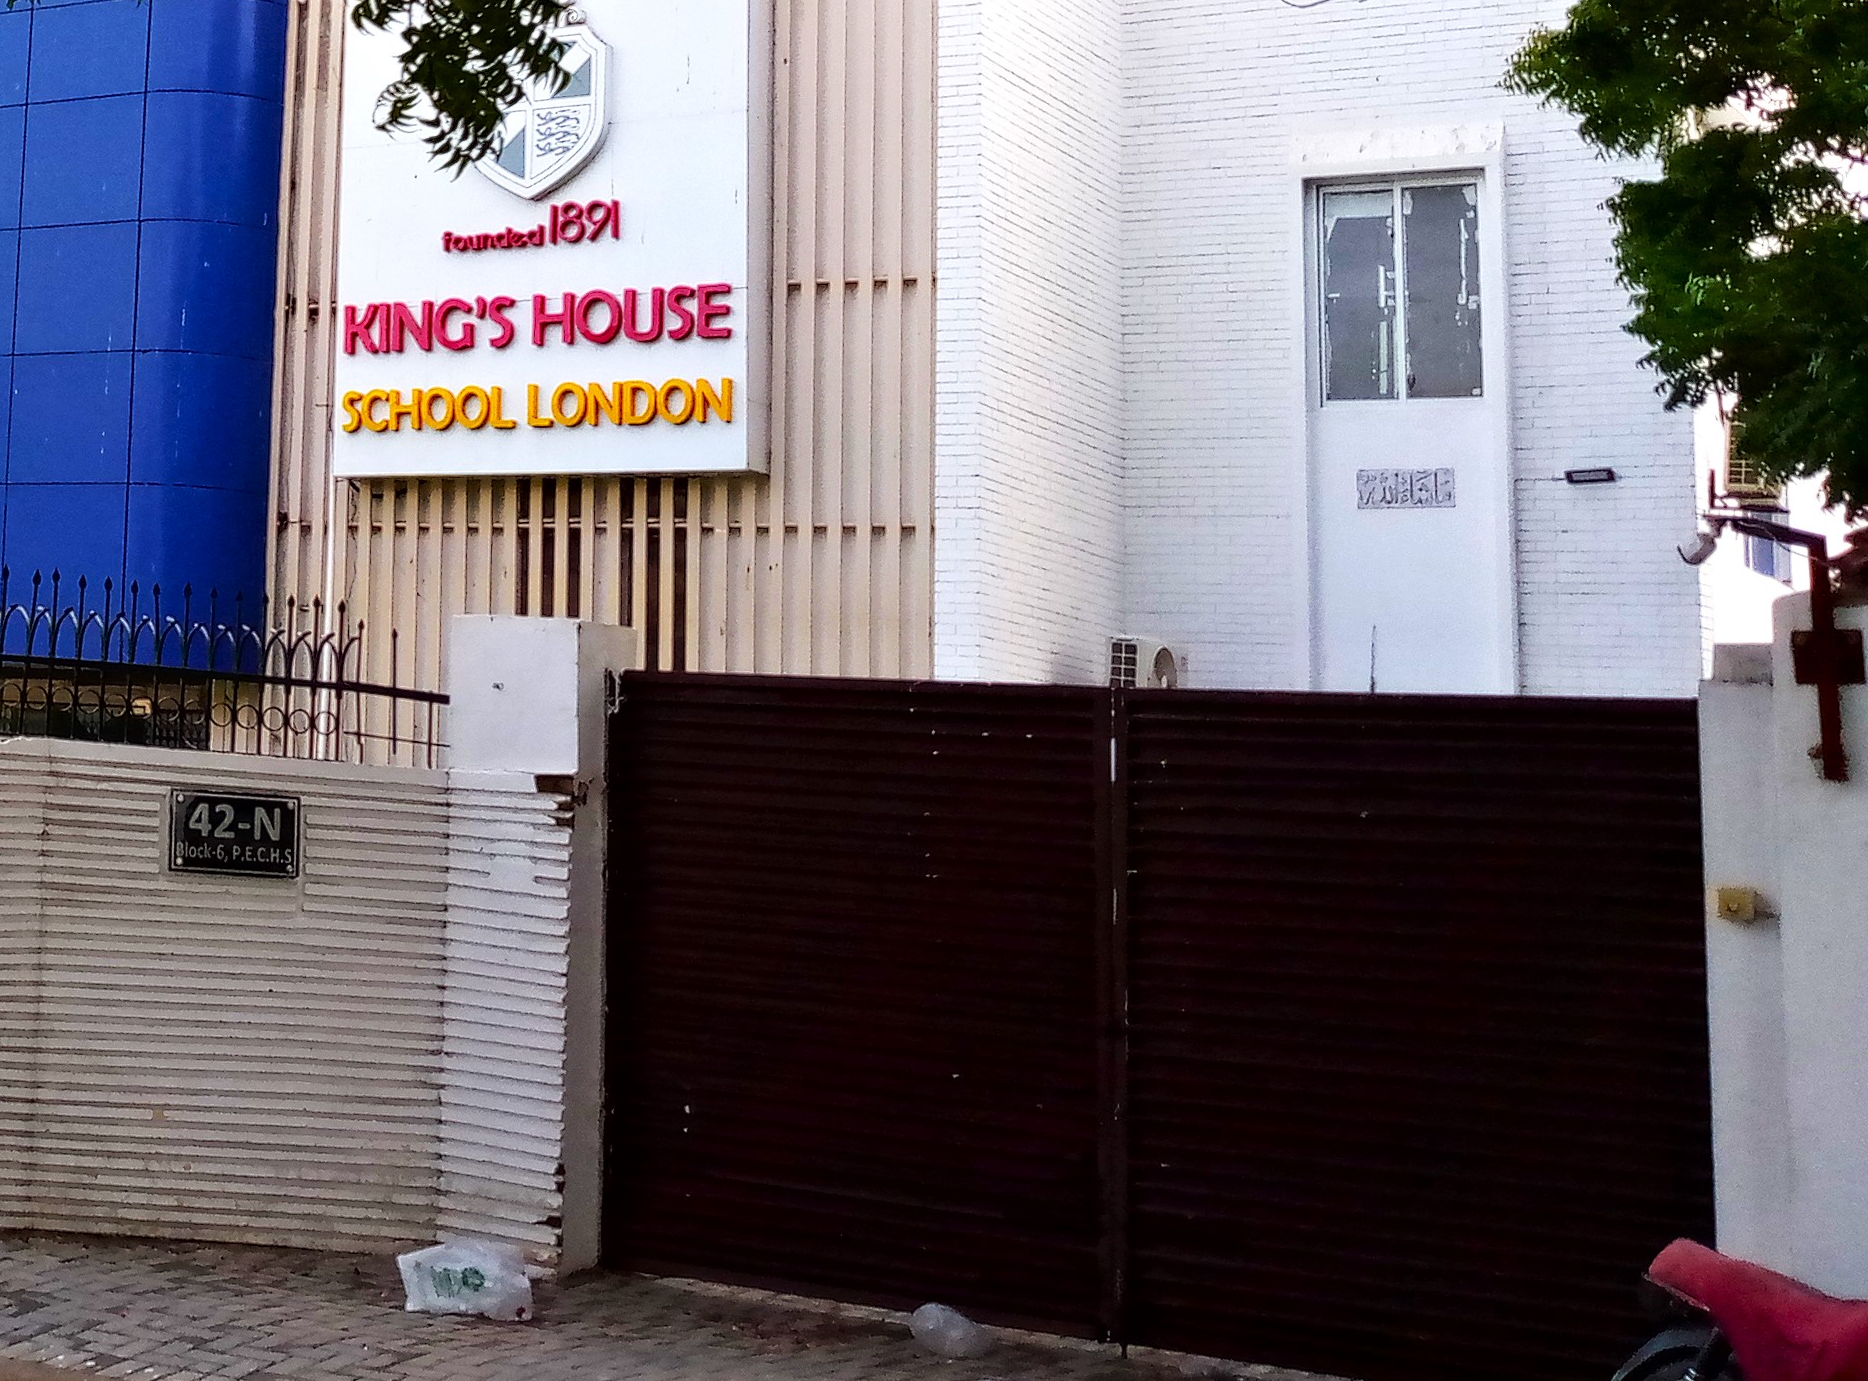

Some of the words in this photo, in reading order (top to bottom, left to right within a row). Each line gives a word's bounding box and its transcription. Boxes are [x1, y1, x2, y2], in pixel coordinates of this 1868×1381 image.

[441, 224, 544, 253] founded
[548, 199, 621, 246] 1891
[343, 295, 516, 356] KING'S
[532, 284, 733, 346] HOUSE
[342, 385, 517, 433] SCHOOL
[527, 378, 734, 428] LONDON
[188, 802, 281, 842] 42-N
